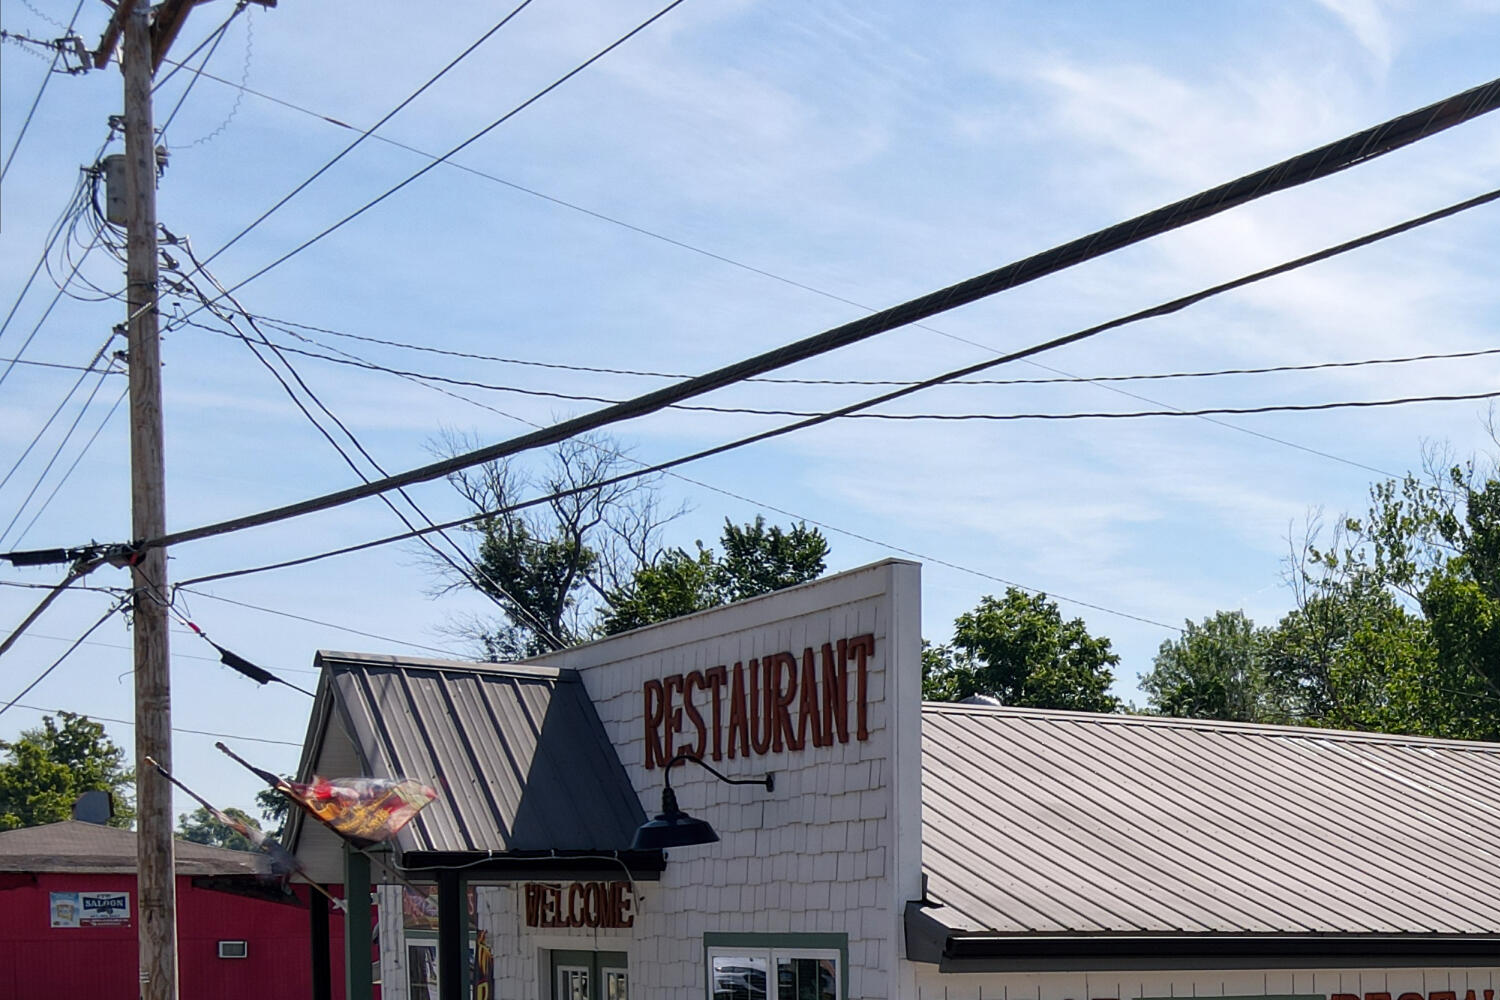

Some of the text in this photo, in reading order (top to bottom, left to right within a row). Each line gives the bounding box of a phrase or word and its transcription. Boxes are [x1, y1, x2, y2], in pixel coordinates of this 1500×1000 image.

[643, 633, 876, 770] RESTAURANT
[85, 899, 124, 908] SALOON
[525, 882, 634, 928] WELCOME
